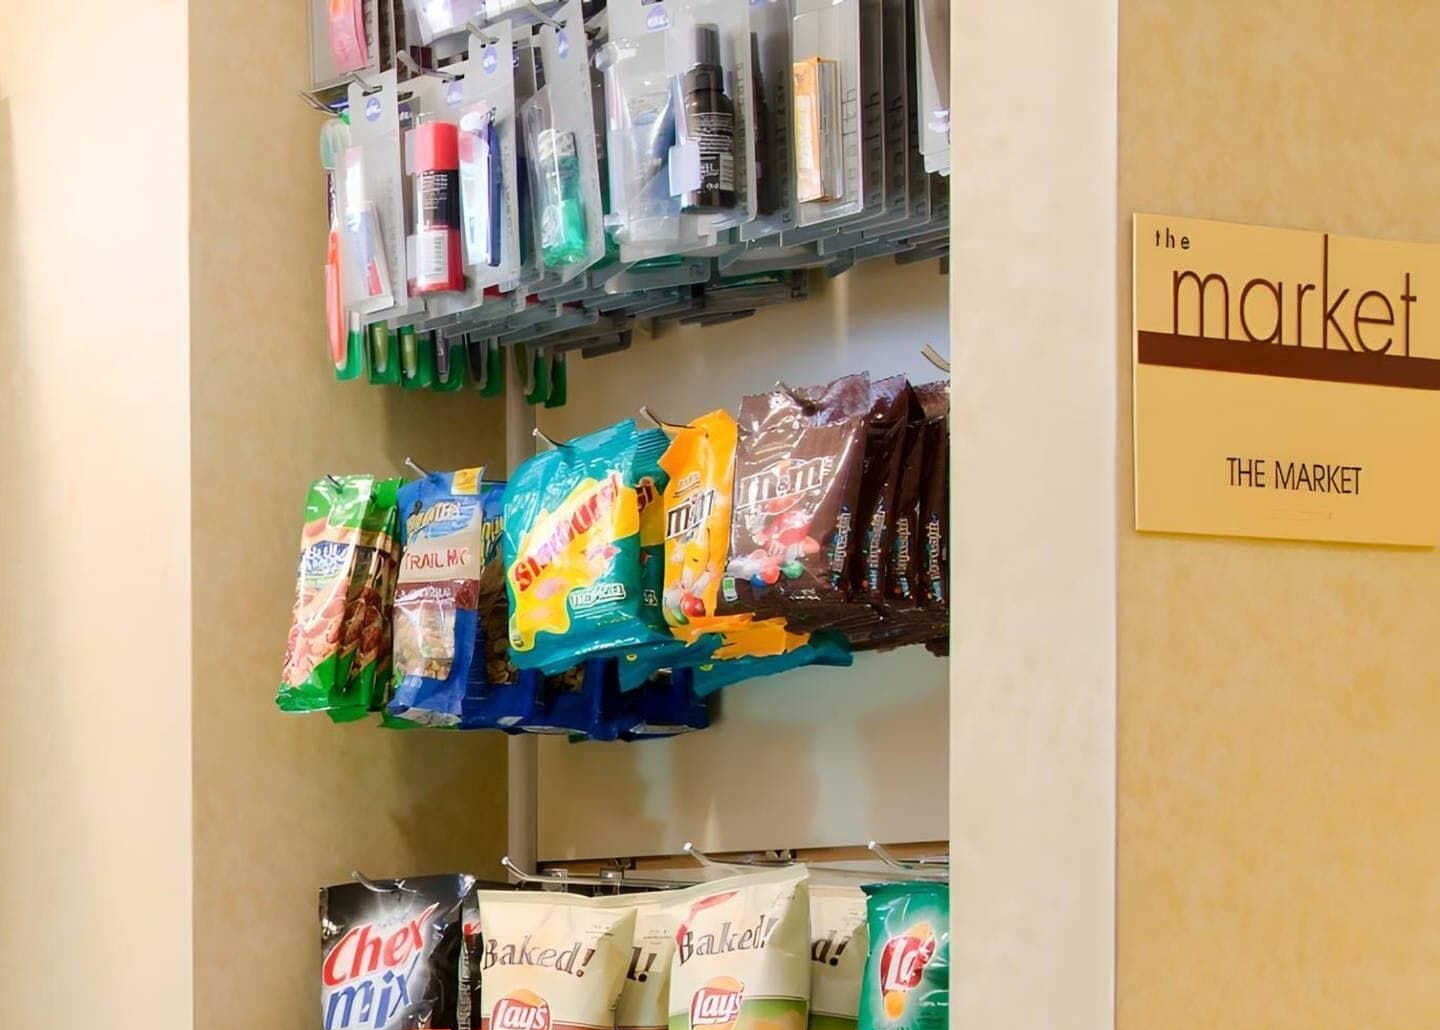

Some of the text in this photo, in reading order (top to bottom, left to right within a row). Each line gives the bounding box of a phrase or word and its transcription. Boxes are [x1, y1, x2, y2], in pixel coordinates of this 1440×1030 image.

[1155, 228, 1191, 250] the
[1172, 233, 1418, 358] market
[1226, 456, 1363, 496] THE MARKET
[322, 902, 440, 987] Chex
[482, 934, 597, 978] Baked!
[678, 913, 780, 967] Baked!
